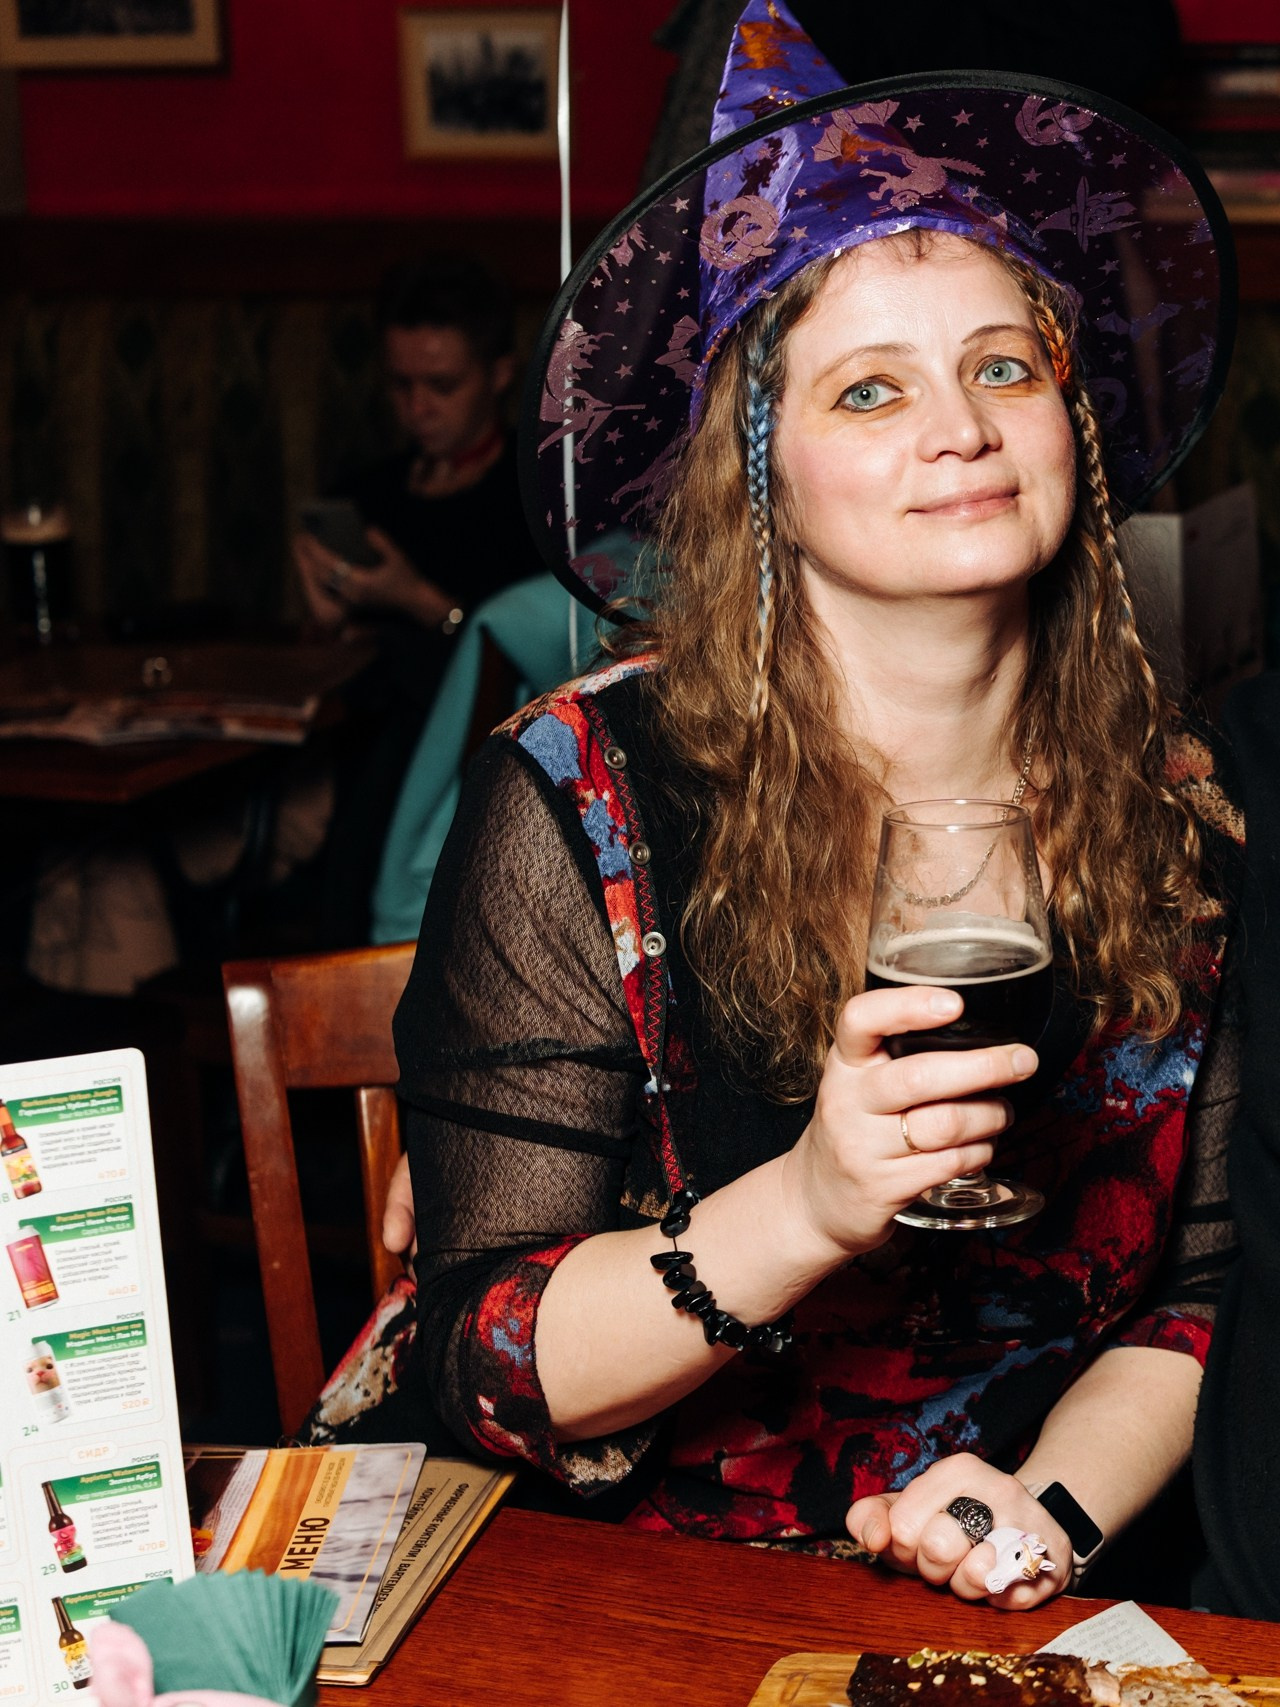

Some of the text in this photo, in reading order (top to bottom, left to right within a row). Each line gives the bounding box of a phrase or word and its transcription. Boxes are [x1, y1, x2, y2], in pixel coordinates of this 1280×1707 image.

[7, 1310, 21, 1321] 21
[116, 1311, 145, 1320] РОССИЯ
[122, 1400, 141, 1409] 520
[22, 1424, 39, 1437] 24
[77, 1446, 109, 1458] СИДР
[131, 1453, 159, 1463] РОССИЯ
[405, 1487, 436, 1524] КОКТЕЙЛИ
[406, 1483, 470, 1558] ФИРМЕННЫЕ КОКТЕЙЛИ
[138, 1542, 157, 1552] 470
[280, 1517, 330, 1570] МЕНЮ
[41, 1564, 57, 1576] 29
[145, 1569, 173, 1578] РОССИЯ
[379, 1563, 411, 1603] BARTENDER
[65, 1594, 96, 1604] Appleton
[97, 1588, 126, 1597] Coconut
[53, 1681, 69, 1693] 30
